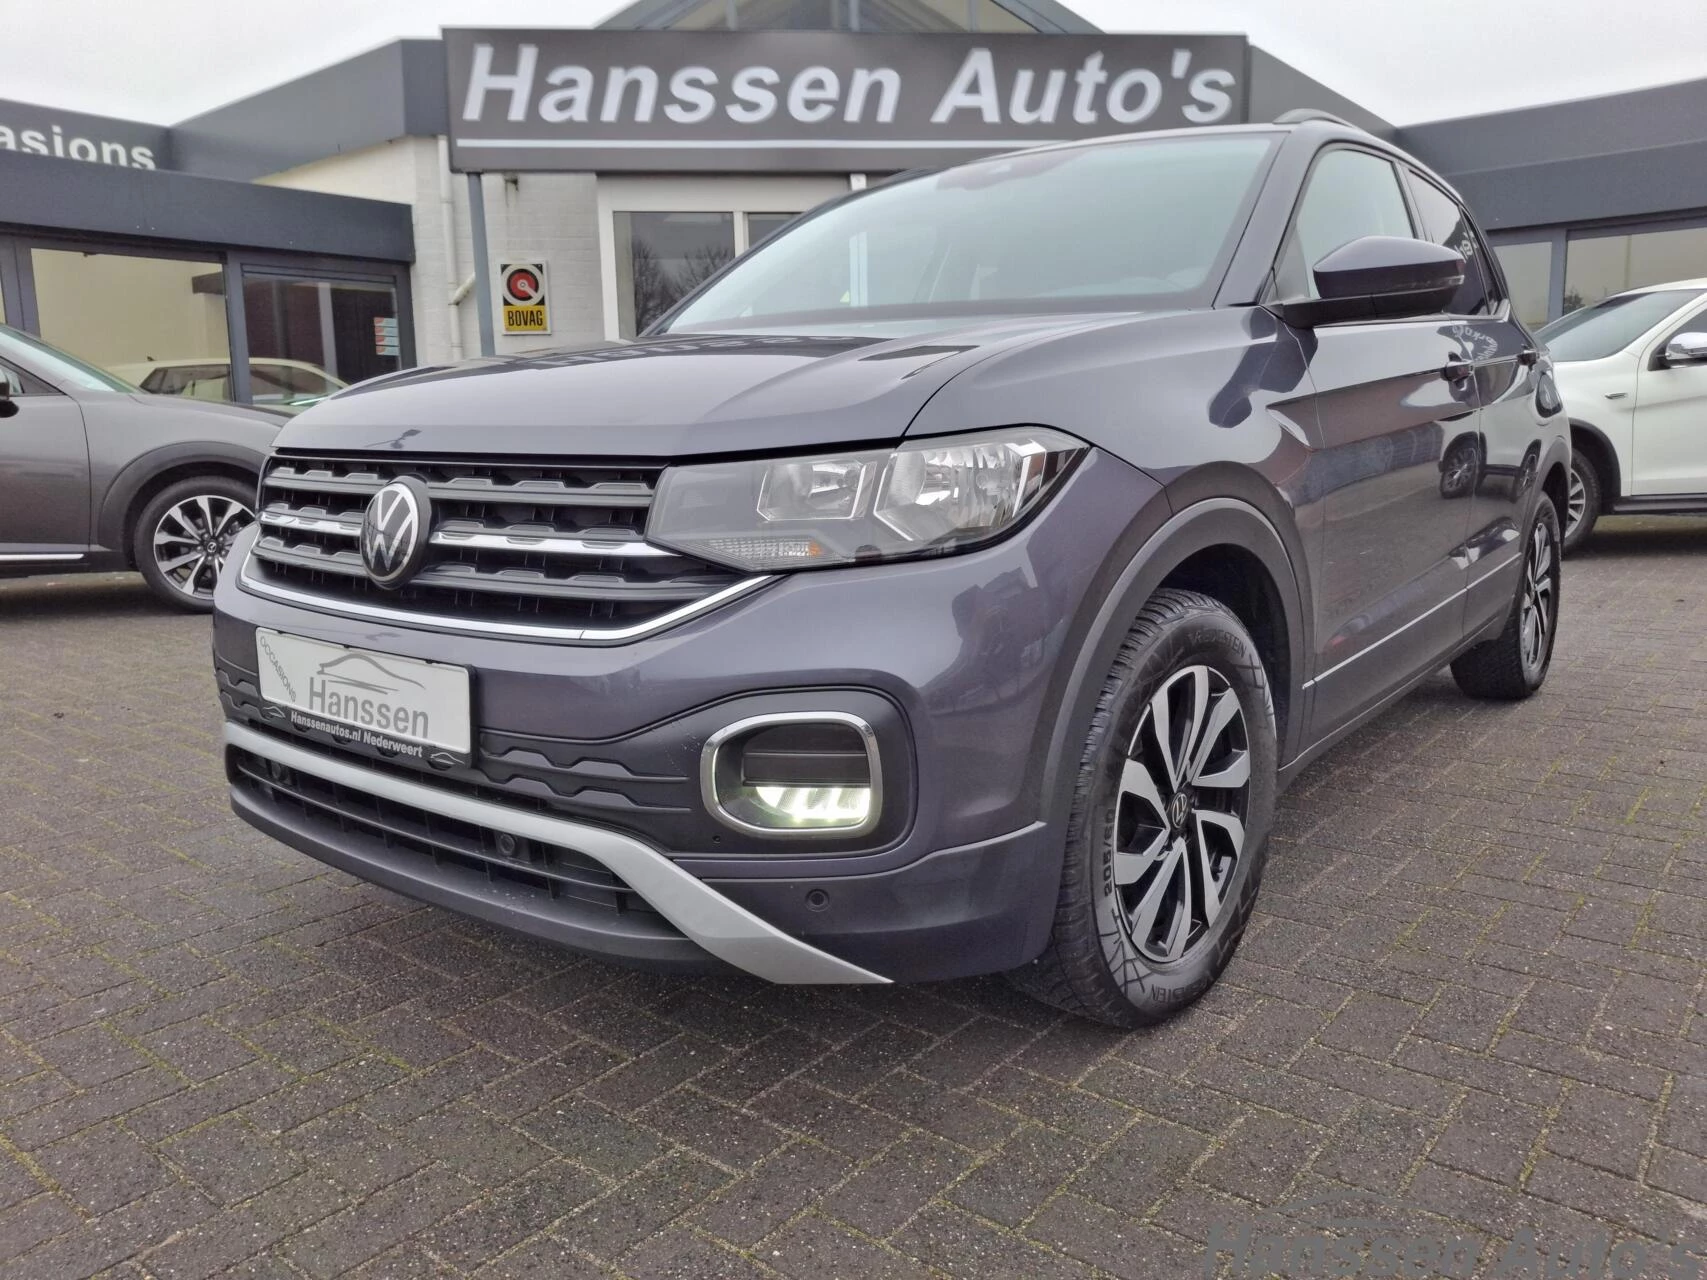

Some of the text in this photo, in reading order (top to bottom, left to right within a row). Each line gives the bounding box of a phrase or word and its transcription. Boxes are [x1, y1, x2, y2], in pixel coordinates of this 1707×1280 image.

[462, 43, 1236, 126] Hanssen Auto's
[507, 310, 543, 327] BOVAG
[260, 636, 296, 702] OCCASIONS
[290, 710, 423, 758] Hanssenautos.nl Nederweert
[308, 676, 429, 740] Hanssen
